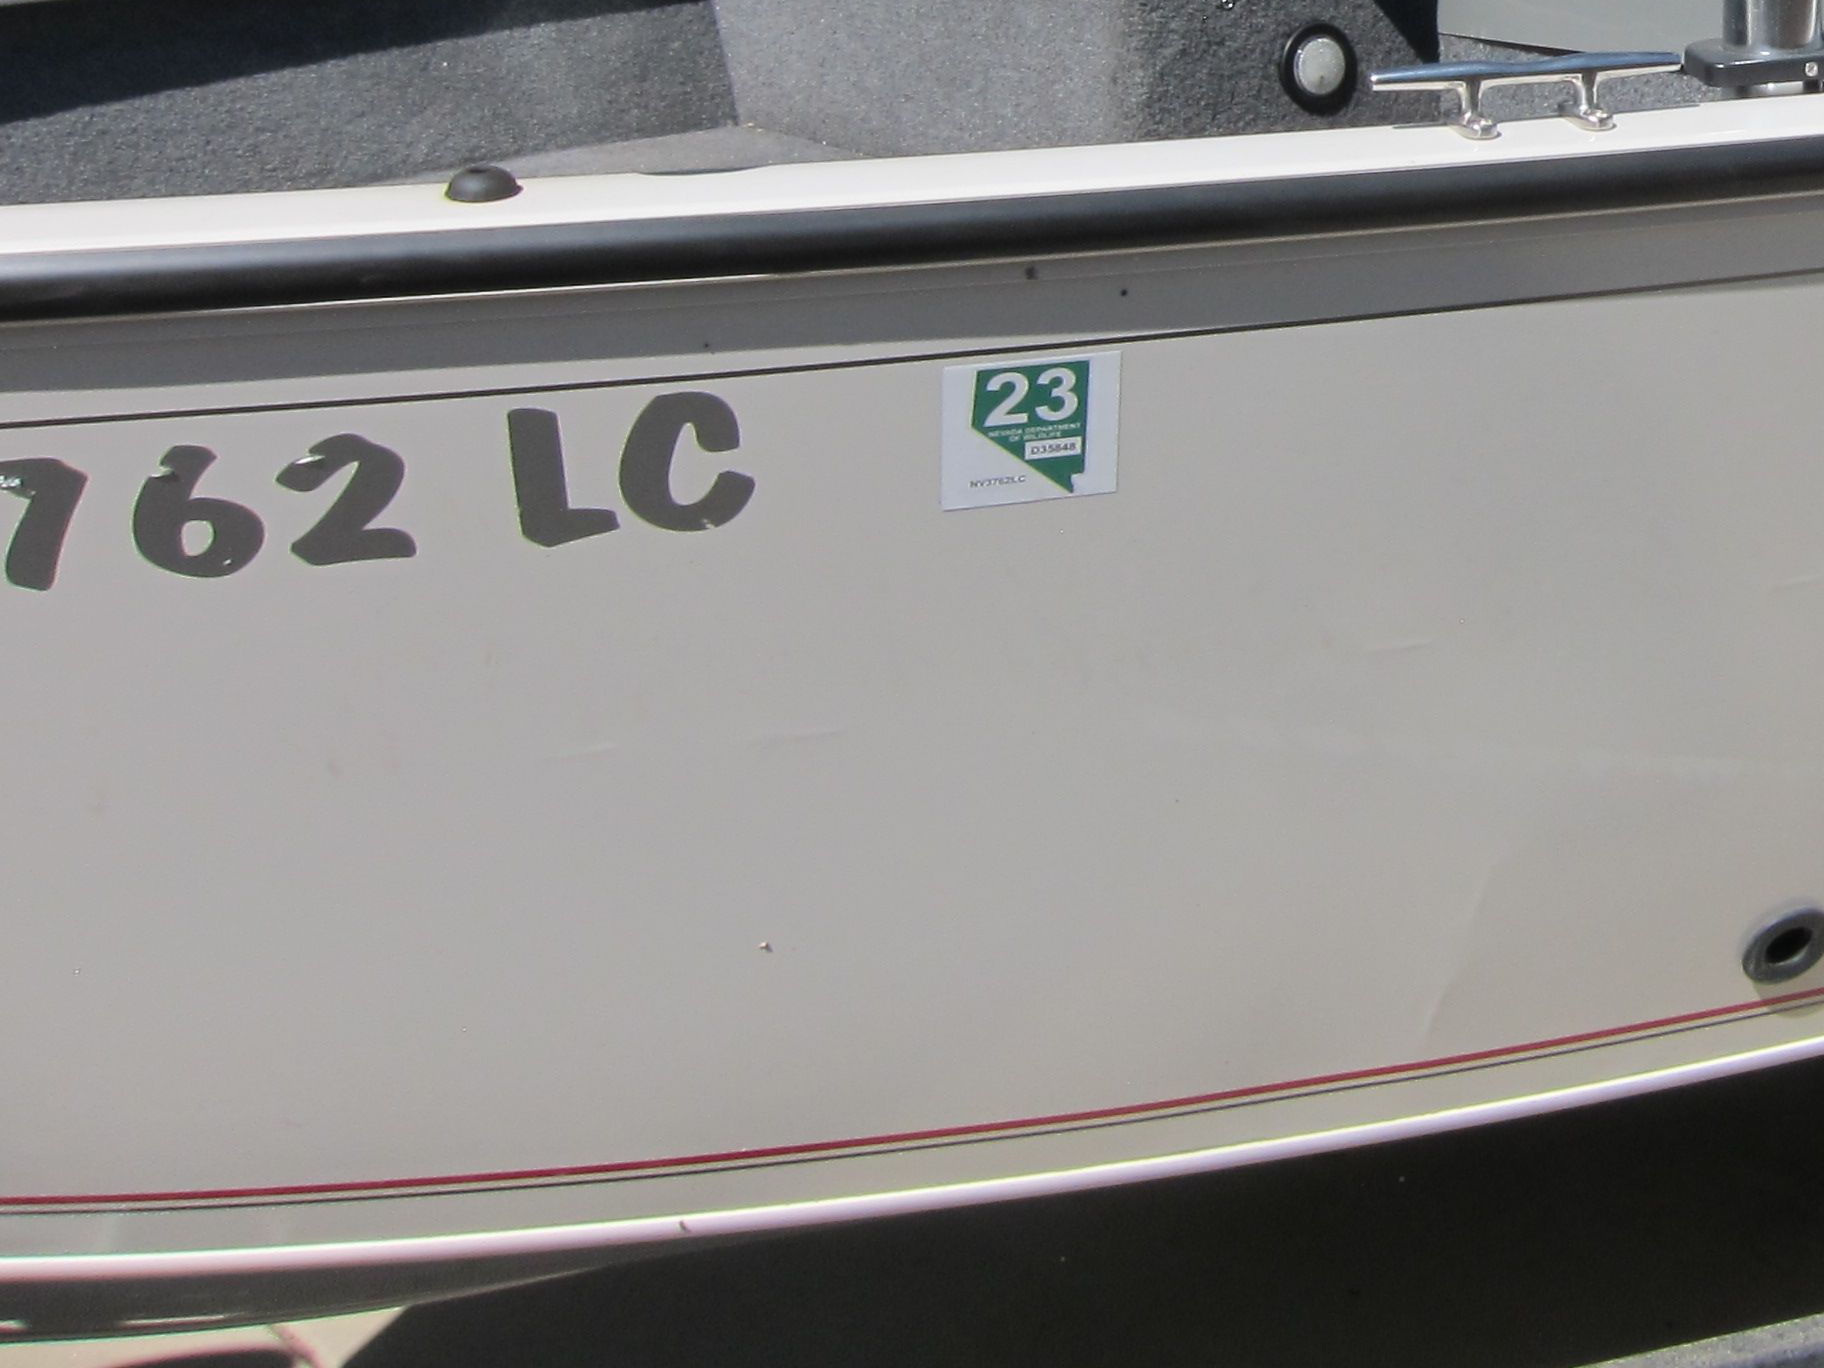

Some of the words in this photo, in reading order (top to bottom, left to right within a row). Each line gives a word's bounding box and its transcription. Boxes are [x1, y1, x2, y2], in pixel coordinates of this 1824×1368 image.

[983, 367, 1079, 428] 23
[1024, 422, 1081, 433] DEPARTMENT
[507, 391, 756, 548] LC
